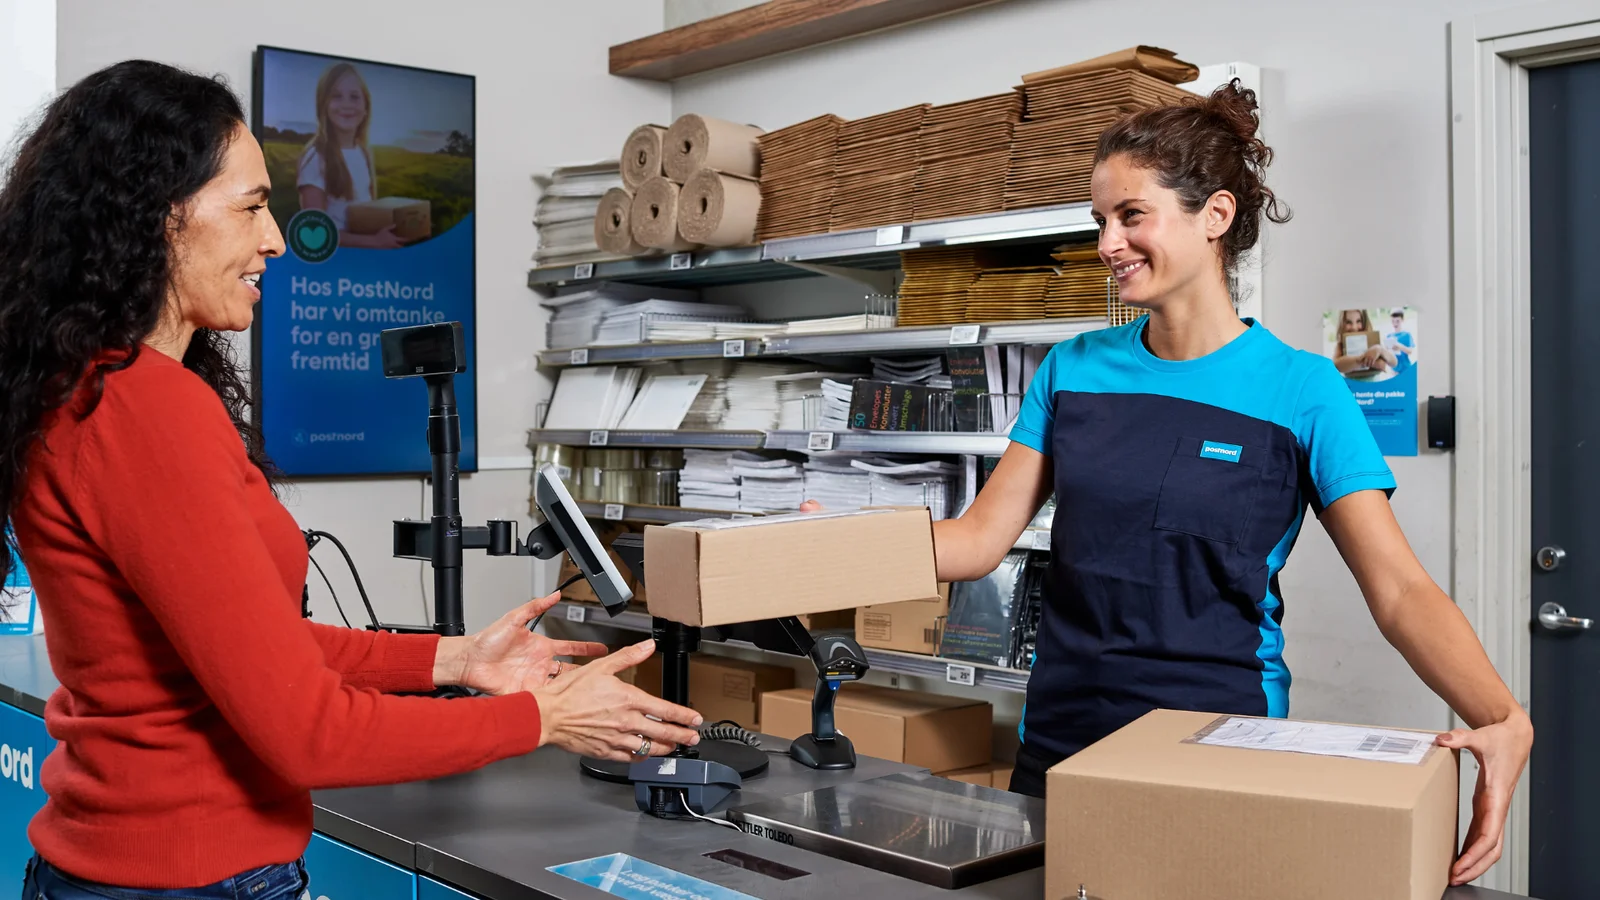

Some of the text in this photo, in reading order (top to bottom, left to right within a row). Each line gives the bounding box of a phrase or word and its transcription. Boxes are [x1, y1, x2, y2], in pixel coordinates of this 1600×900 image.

[291, 277, 434, 300] Hos PostNord
[291, 301, 446, 324] har vi omtanke
[291, 325, 323, 345] for
[327, 333, 353, 346] en
[291, 351, 370, 371] fremtid
[869, 389, 882, 429] Envelopes
[880, 385, 892, 430] Konvolutter
[889, 404, 899, 431] Kuvert
[854, 412, 866, 428] 50
[309, 431, 365, 442] postnord
[1204, 446, 1238, 456] postnord
[0, 743, 33, 790] ord
[764, 827, 794, 846] TOLEDO
